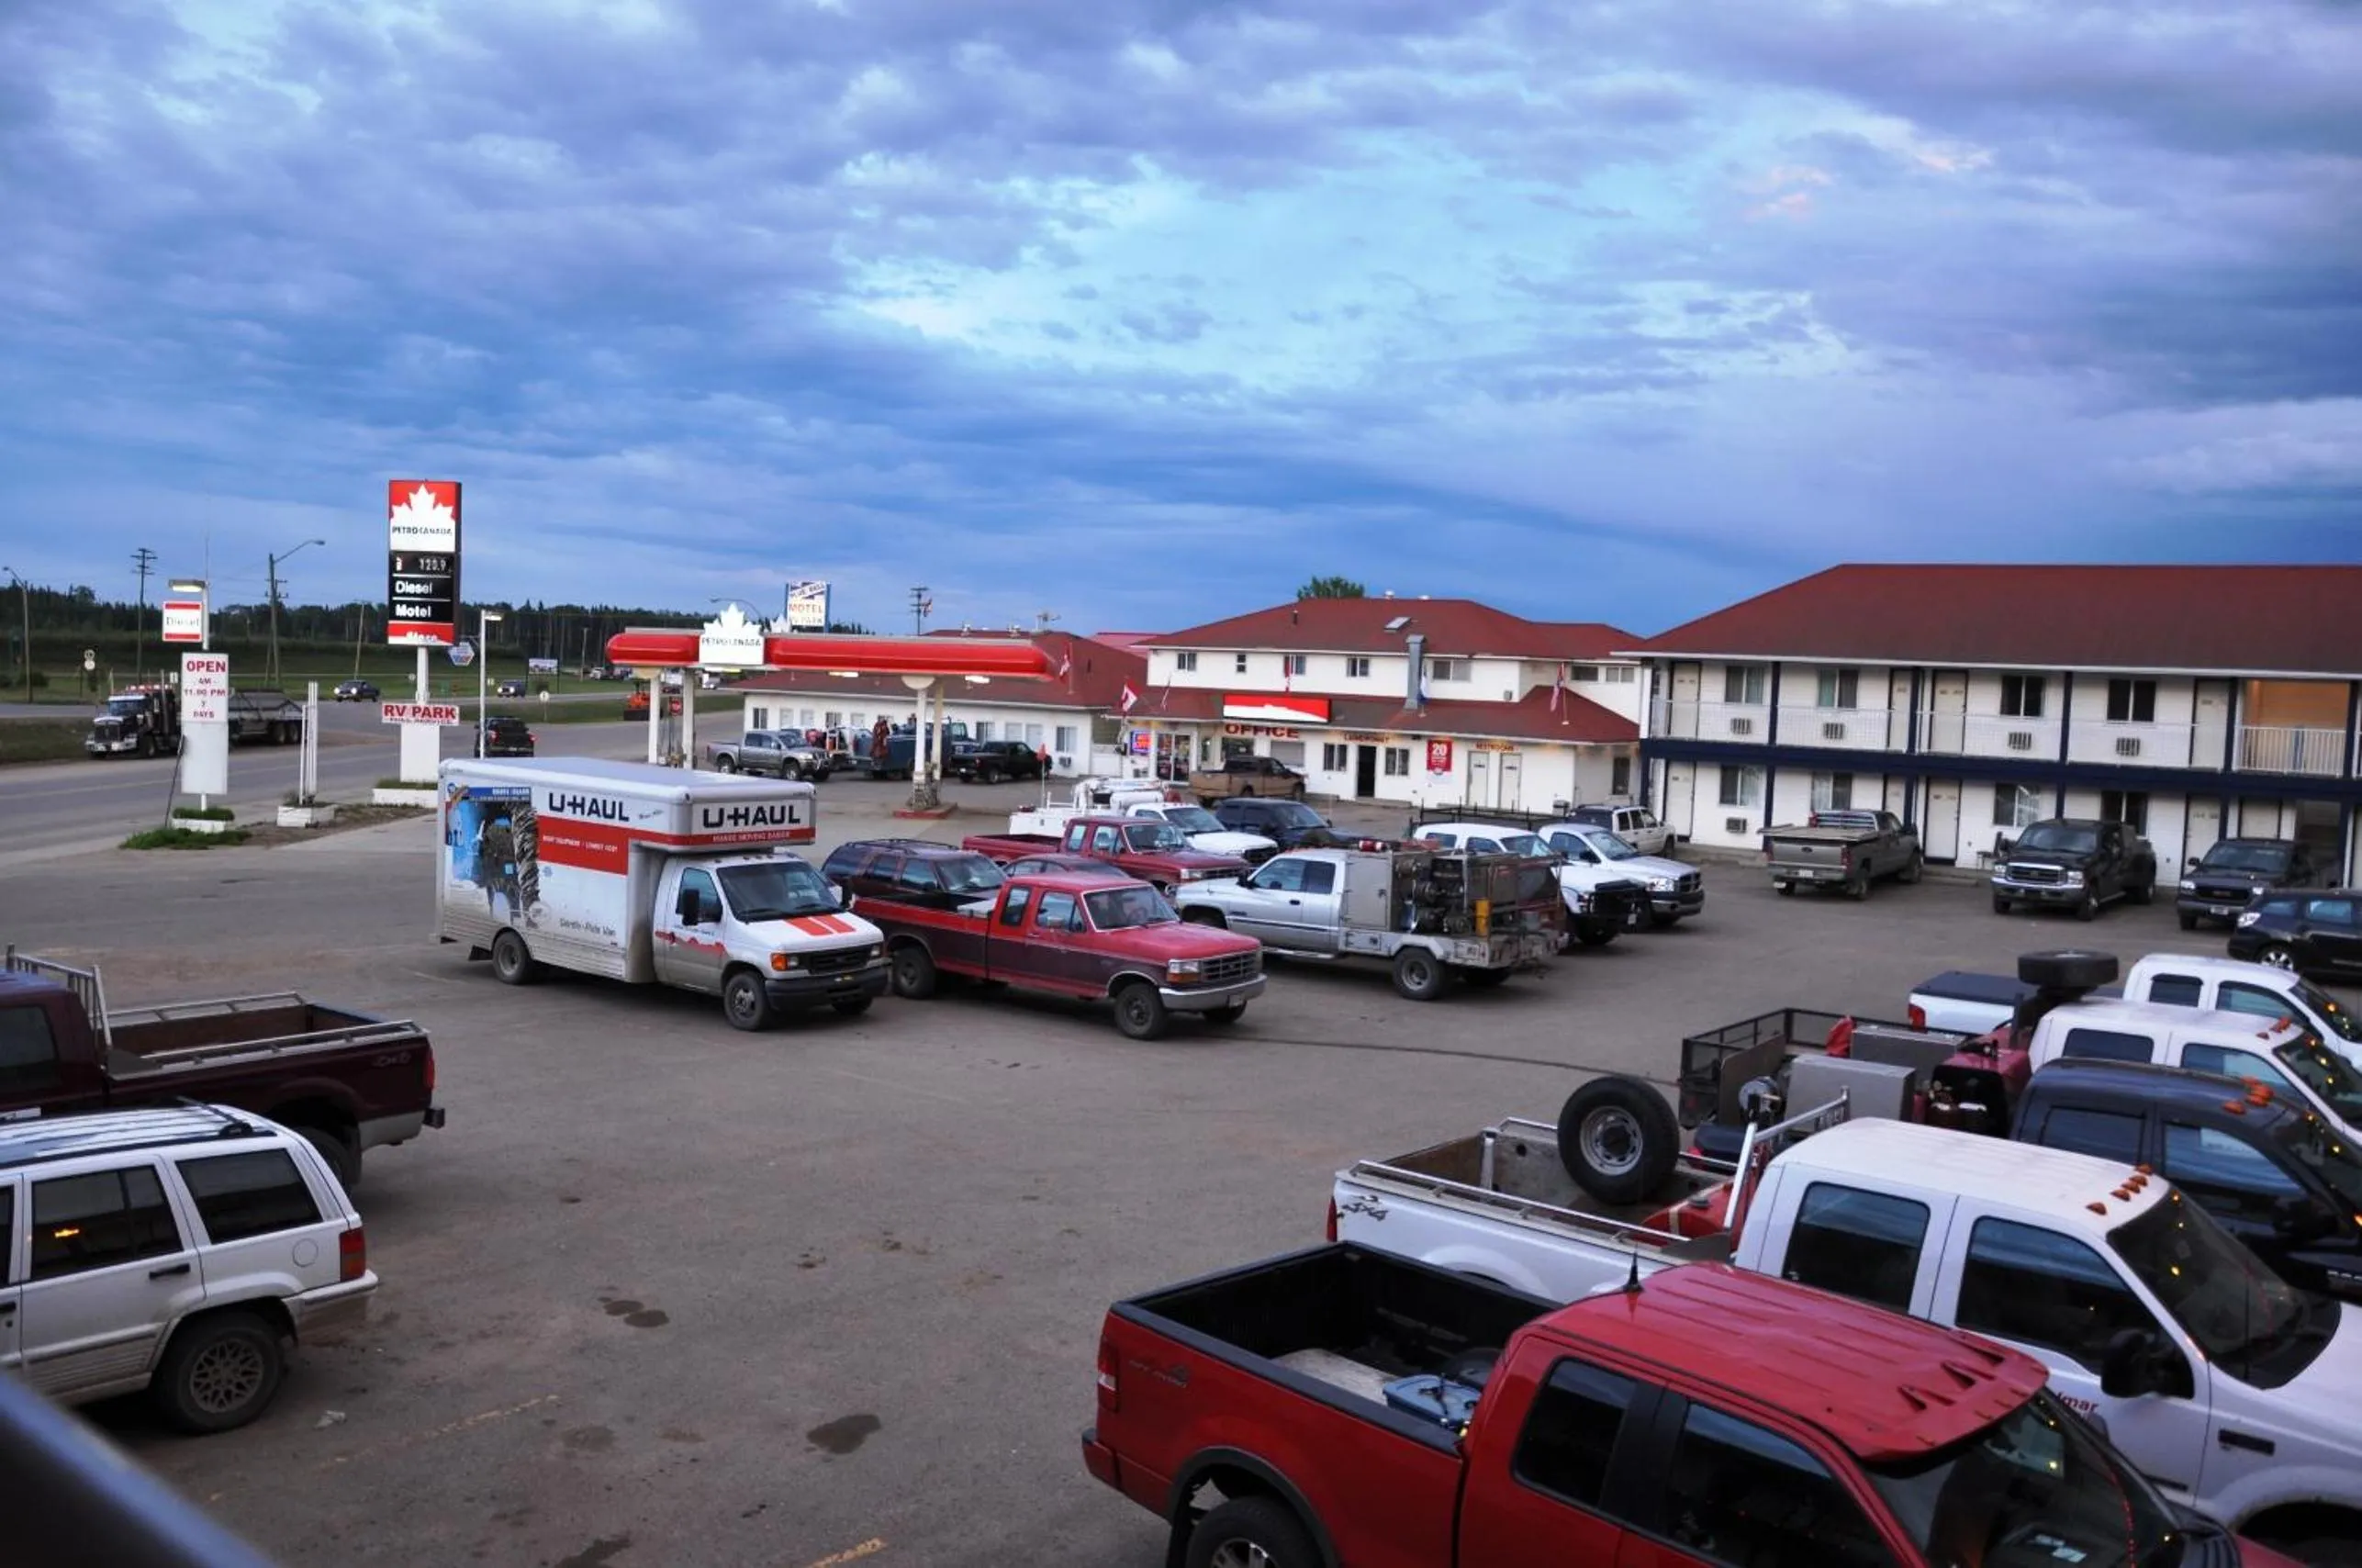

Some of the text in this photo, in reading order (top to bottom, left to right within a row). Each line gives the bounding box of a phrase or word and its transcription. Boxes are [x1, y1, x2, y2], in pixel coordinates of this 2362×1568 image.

[395, 580, 432, 594] Diesel
[395, 604, 431, 617] Motel
[789, 603, 823, 613] MOTEL
[166, 616, 200, 626] Diesel
[186, 660, 226, 672] OPEN
[384, 704, 456, 720] RV PARK
[1226, 723, 1299, 739] OFFICE
[1432, 743, 1448, 756] 20
